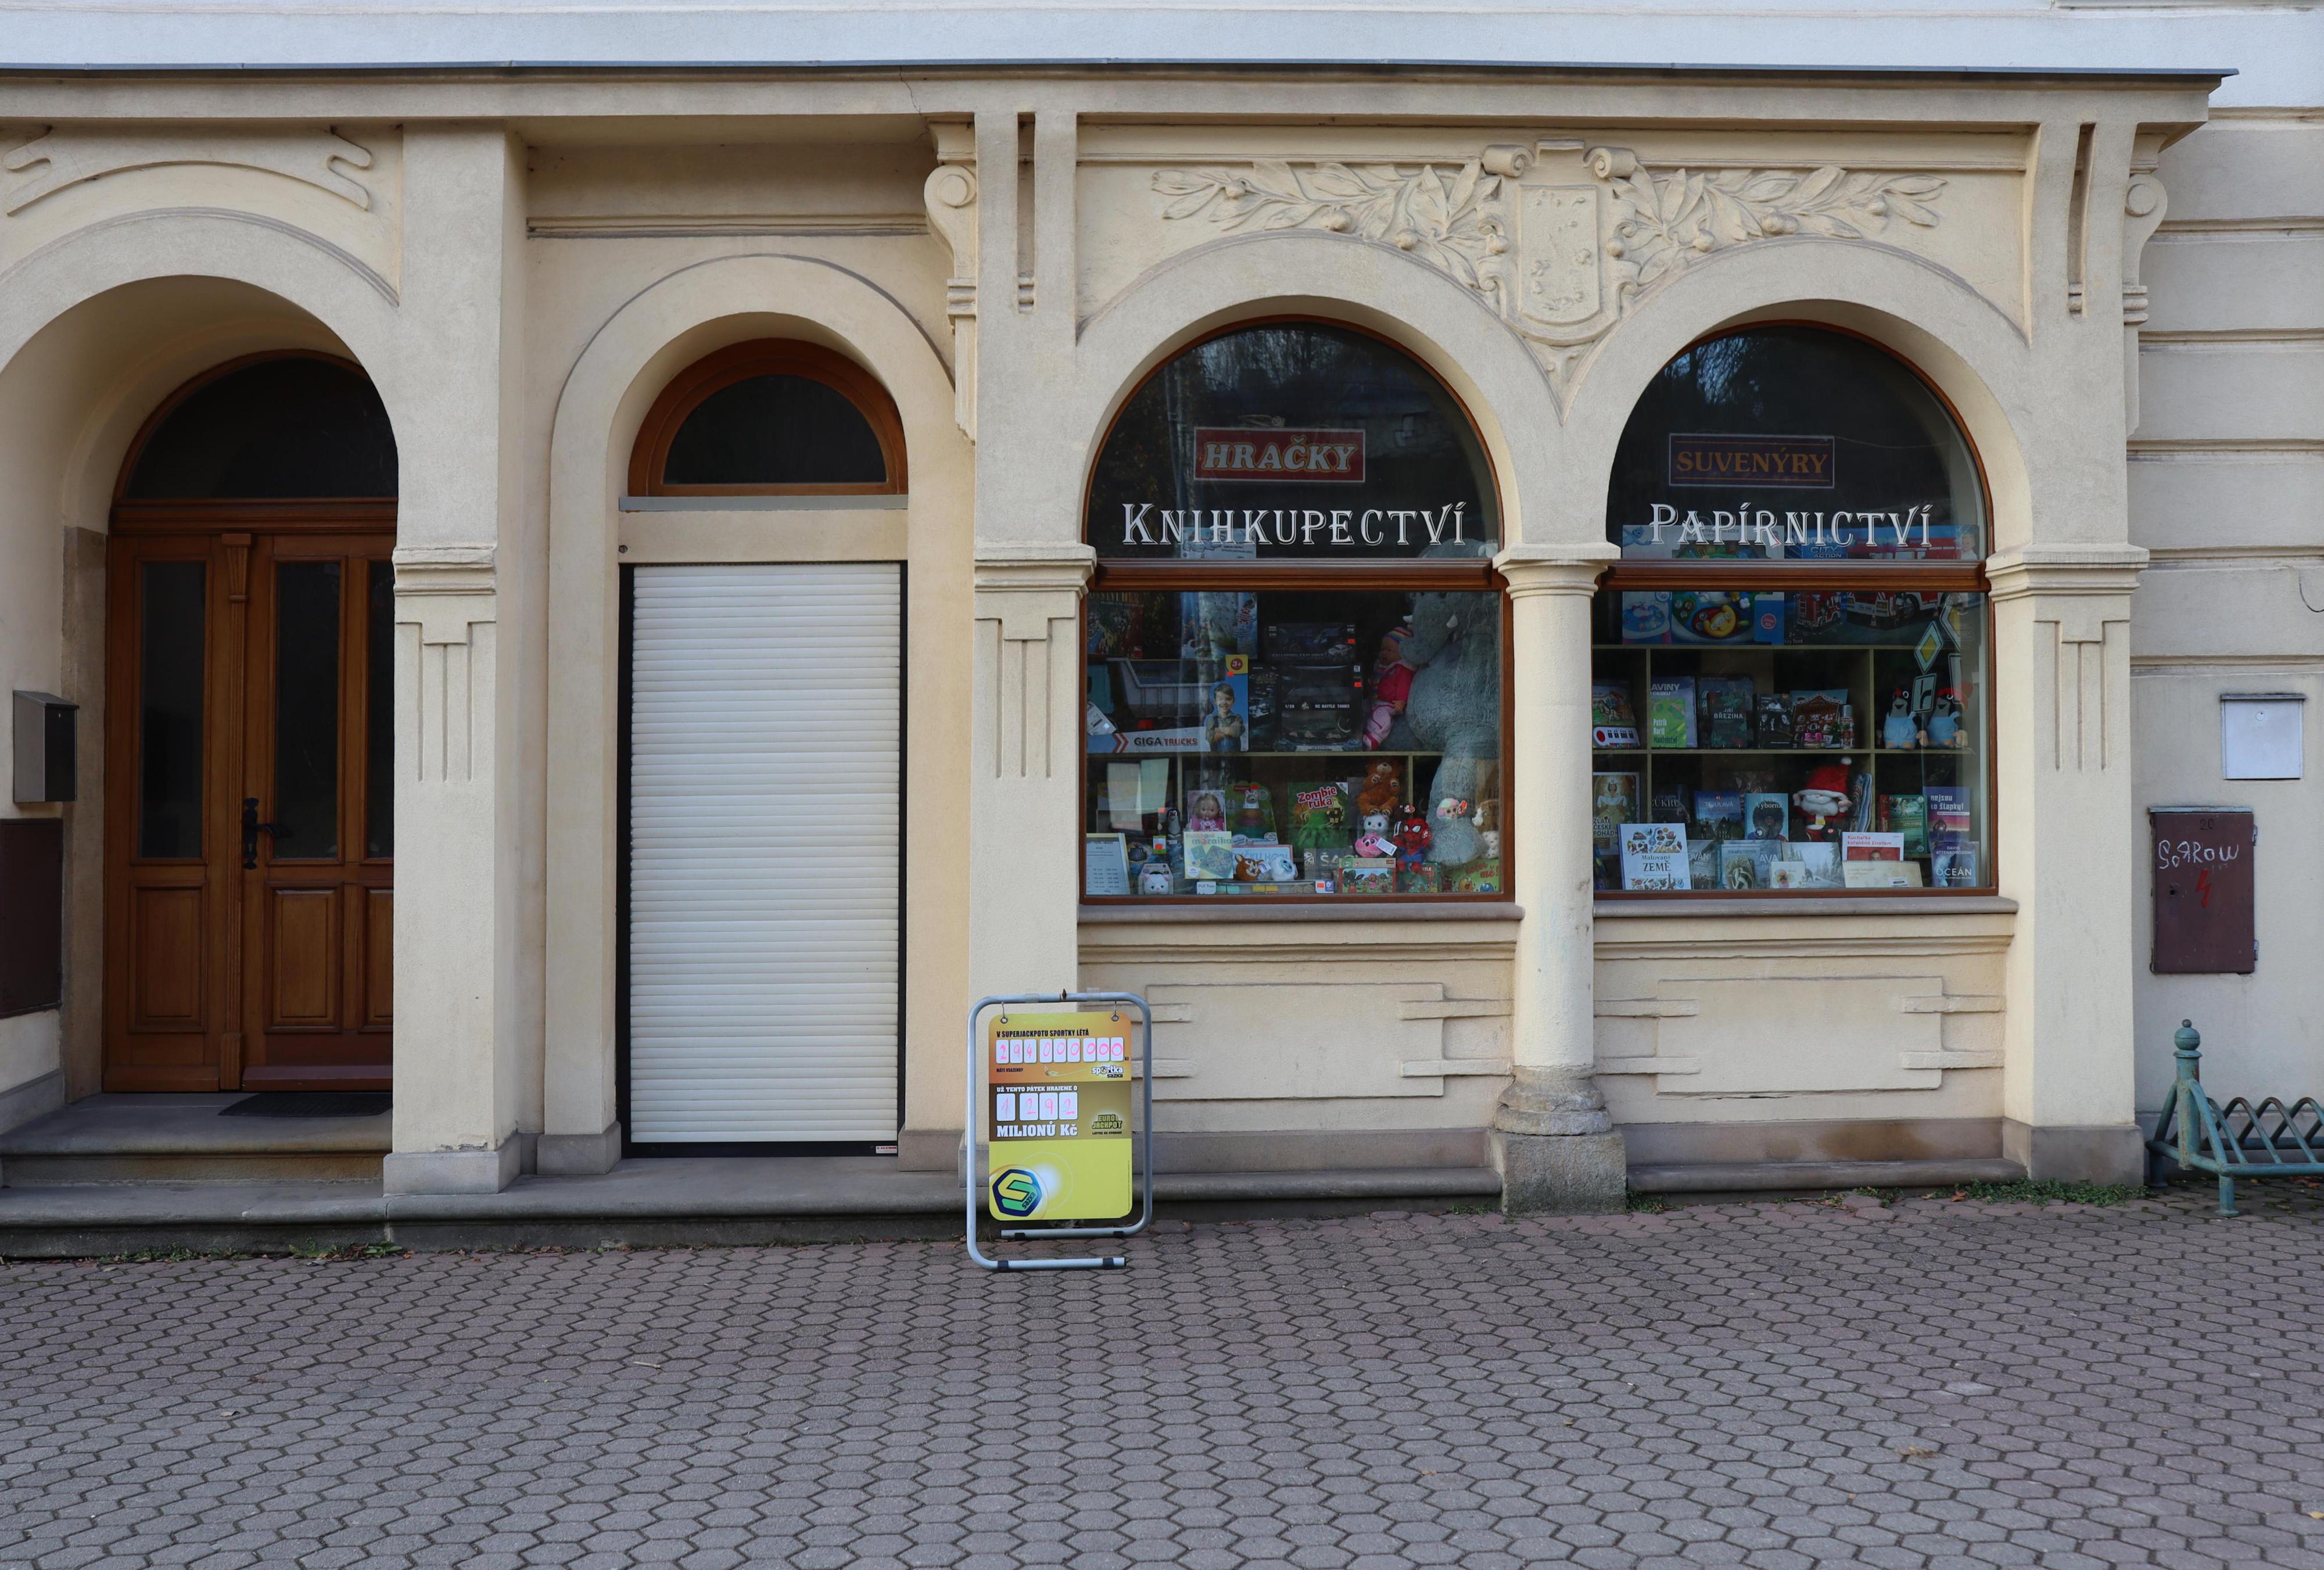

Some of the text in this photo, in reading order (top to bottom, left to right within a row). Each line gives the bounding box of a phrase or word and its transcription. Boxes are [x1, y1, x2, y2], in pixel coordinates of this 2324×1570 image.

[1203, 435, 1357, 472] HRAČKY
[1676, 447, 1828, 475] SUVENÝRY
[1122, 501, 1468, 547] KNIHKUPECTVÍ
[1649, 502, 1934, 549] PAPÍRNICTVÍ
[1651, 683, 1680, 691] AVINY
[1713, 711, 1744, 719] BŘEZINA
[1134, 737, 1162, 746] GIGA
[1164, 737, 1198, 746] TRUCKS
[1296, 786, 1337, 804] Zombie
[1930, 794, 1953, 802] nejsou
[1307, 797, 1333, 809] ruka
[2199, 818, 2214, 830] 20
[1192, 836, 1232, 844] mozaika
[1643, 860, 1671, 872] ZEMĚ
[1936, 866, 1972, 876] OCEÁN
[1091, 1066, 1124, 1074] sportka
[996, 1121, 1078, 1138] MILIONŮ Kč
[1092, 1121, 1122, 1130] JACKPOT
